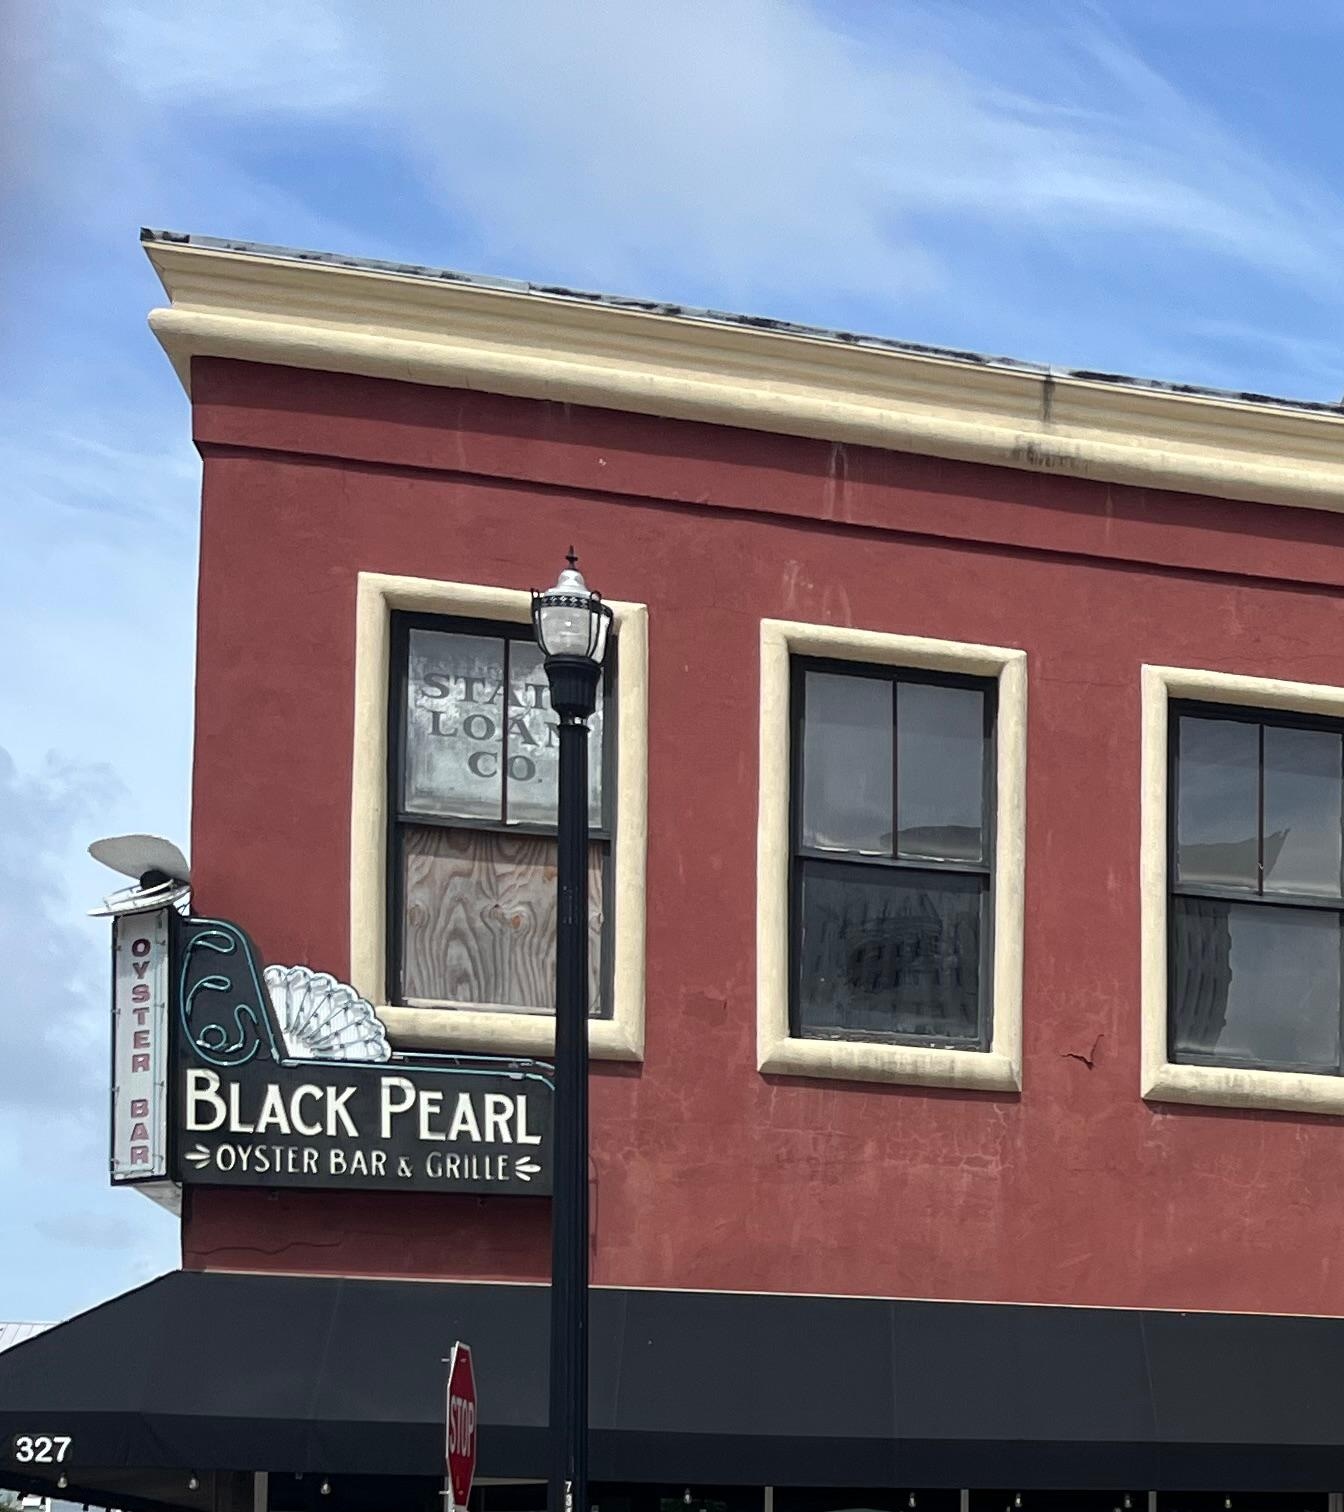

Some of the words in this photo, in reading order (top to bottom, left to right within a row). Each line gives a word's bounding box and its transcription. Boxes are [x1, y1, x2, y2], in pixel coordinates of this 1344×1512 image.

[419, 672, 551, 711] STAT
[467, 751, 543, 783] CO.
[131, 938, 151, 1073] OYSTER
[130, 1098, 150, 1165] BAR
[185, 1068, 360, 1138] BLACK
[381, 1076, 542, 1145] PEARL
[215, 1144, 319, 1174] OYSTER
[330, 1150, 387, 1176] BAR
[398, 1155, 414, 1178] &
[426, 1152, 510, 1181] GRILLE
[15, 1435, 73, 1463] 327
[450, 1394, 474, 1458] STOP
